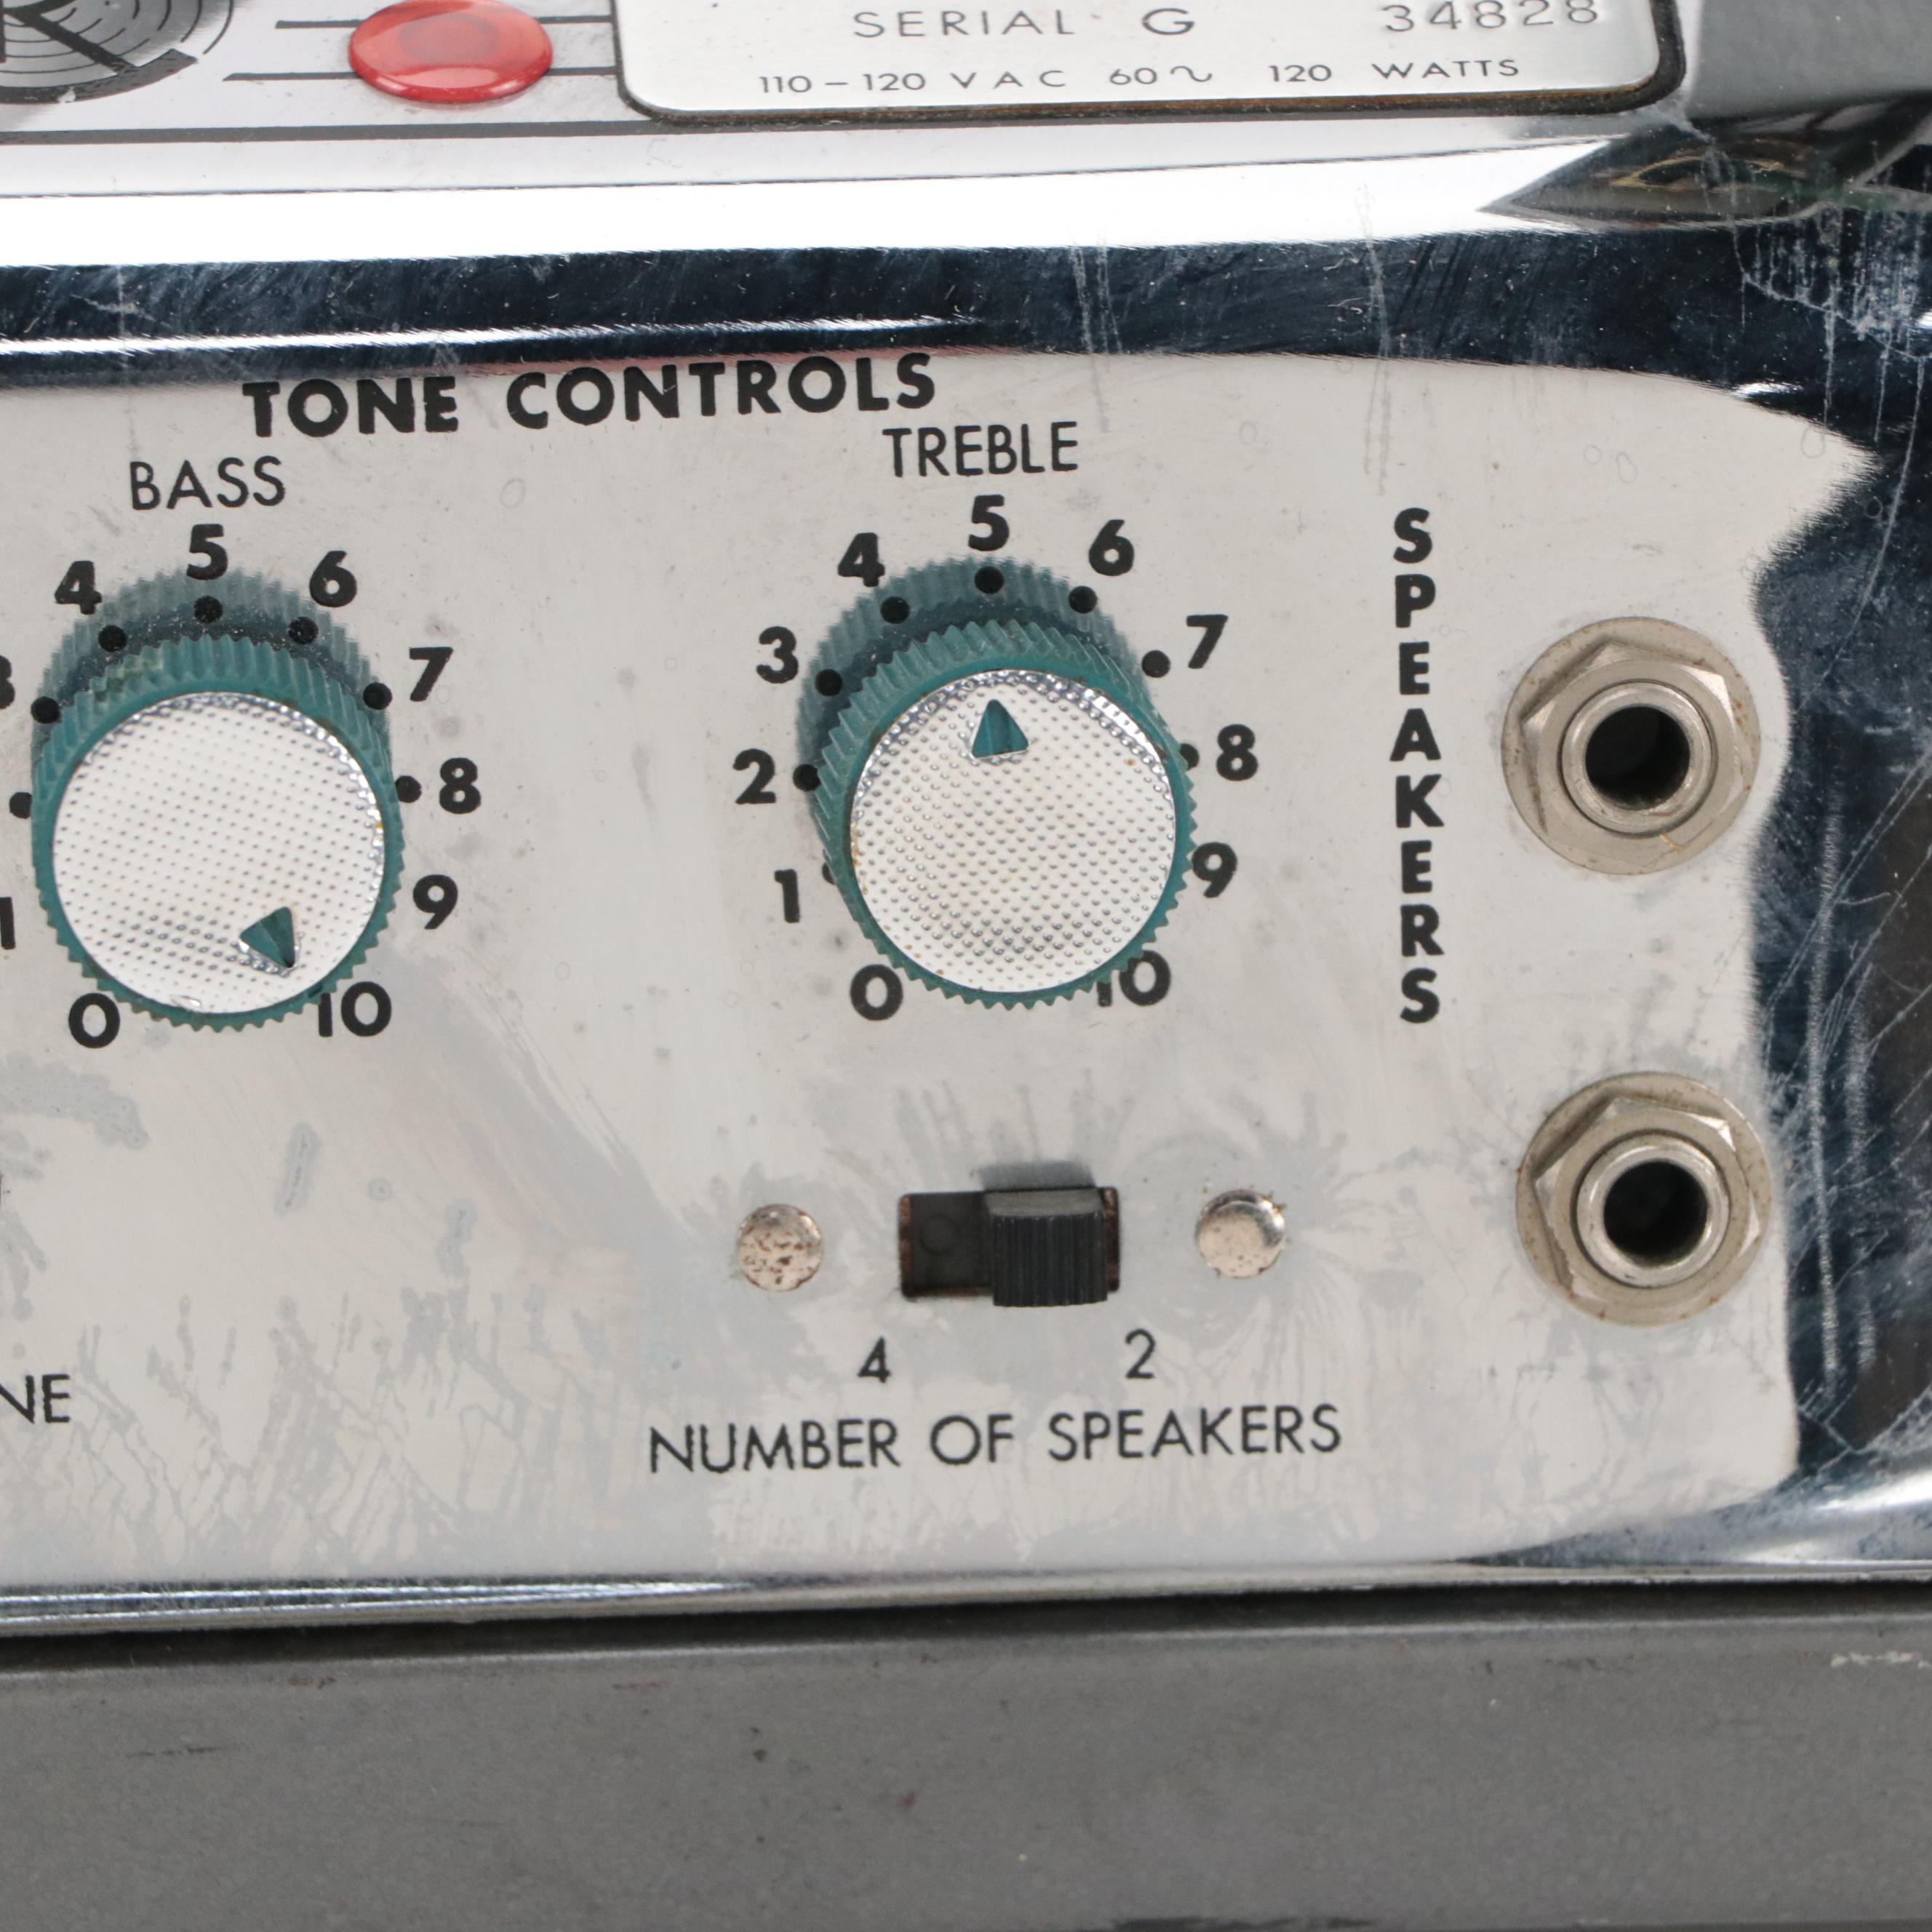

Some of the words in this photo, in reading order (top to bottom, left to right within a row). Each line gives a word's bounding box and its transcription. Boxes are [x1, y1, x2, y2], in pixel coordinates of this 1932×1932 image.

[854, 9, 1076, 38] SERIAL
[1142, 8, 1194, 36] G
[1382, 0, 1597, 32] 34828
[1269, 64, 1332, 82] 120
[1371, 59, 1520, 79] WATTS
[242, 375, 458, 438] TONE
[506, 352, 935, 429] CONTROLS
[882, 421, 1078, 478] TREBLE
[129, 455, 286, 511] BASS
[968, 495, 1009, 551] 5
[1089, 519, 1134, 577] 6
[186, 524, 228, 580] 5
[309, 551, 356, 608] 6
[838, 532, 885, 587] 4
[55, 561, 103, 615] 4
[757, 626, 799, 684] 3
[1186, 614, 1228, 669] 7
[410, 647, 453, 702] 7
[733, 749, 776, 805] 2
[1216, 724, 1258, 781] 8
[1390, 508, 1444, 1023] SPEAKERS
[439, 757, 481, 815] 8
[775, 869, 800, 923] 1
[1191, 843, 1237, 898] 9
[412, 874, 458, 930] 9
[68, 992, 121, 1049] 0
[316, 981, 391, 1037] 10
[850, 965, 903, 1021] 0
[858, 1338, 890, 1383] 4
[1125, 1329, 1155, 1379] 2
[650, 1418, 900, 1474] NUMBER
[930, 1413, 1013, 1466] OF
[1049, 1403, 1341, 1461] SPEAKERS
